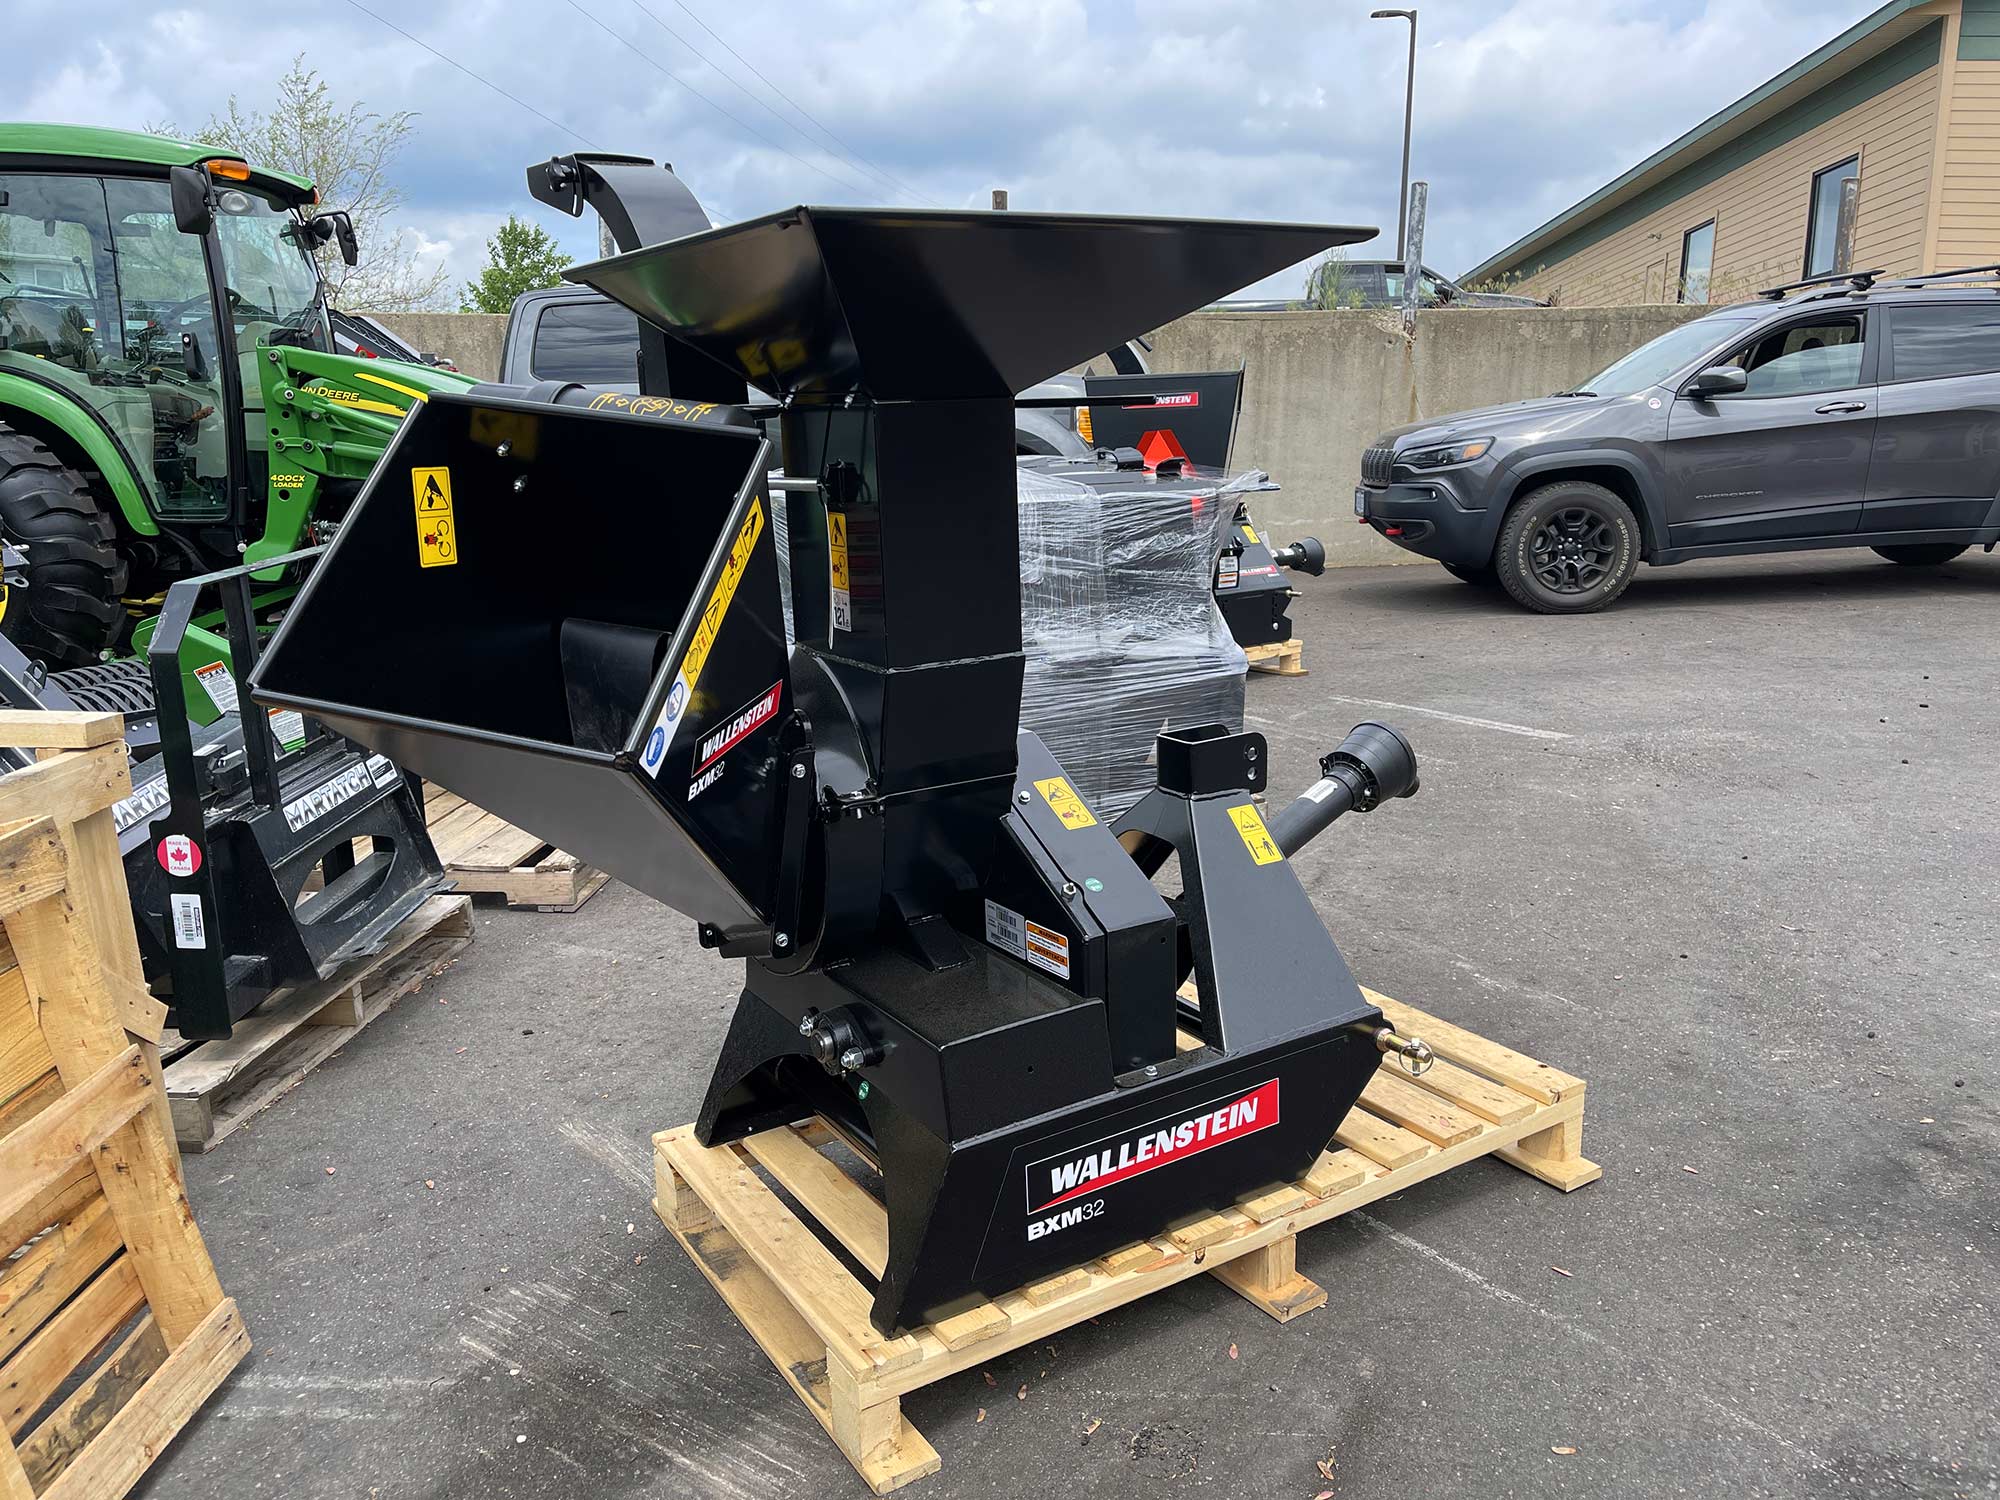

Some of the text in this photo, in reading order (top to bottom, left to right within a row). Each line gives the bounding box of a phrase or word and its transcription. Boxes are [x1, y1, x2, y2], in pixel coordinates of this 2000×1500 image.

[317, 386, 360, 401] DEERE
[1154, 395, 1192, 405] NSTEIN
[270, 474, 305, 482] 400CX
[701, 692, 775, 763] WALLENSTEIN
[114, 775, 169, 829] ARTAT
[285, 763, 372, 832] MARTATCH
[688, 760, 725, 801] BXM32
[1050, 1096, 1259, 1195] WALLENSTEIN
[1027, 1199, 1105, 1242] BXM32
